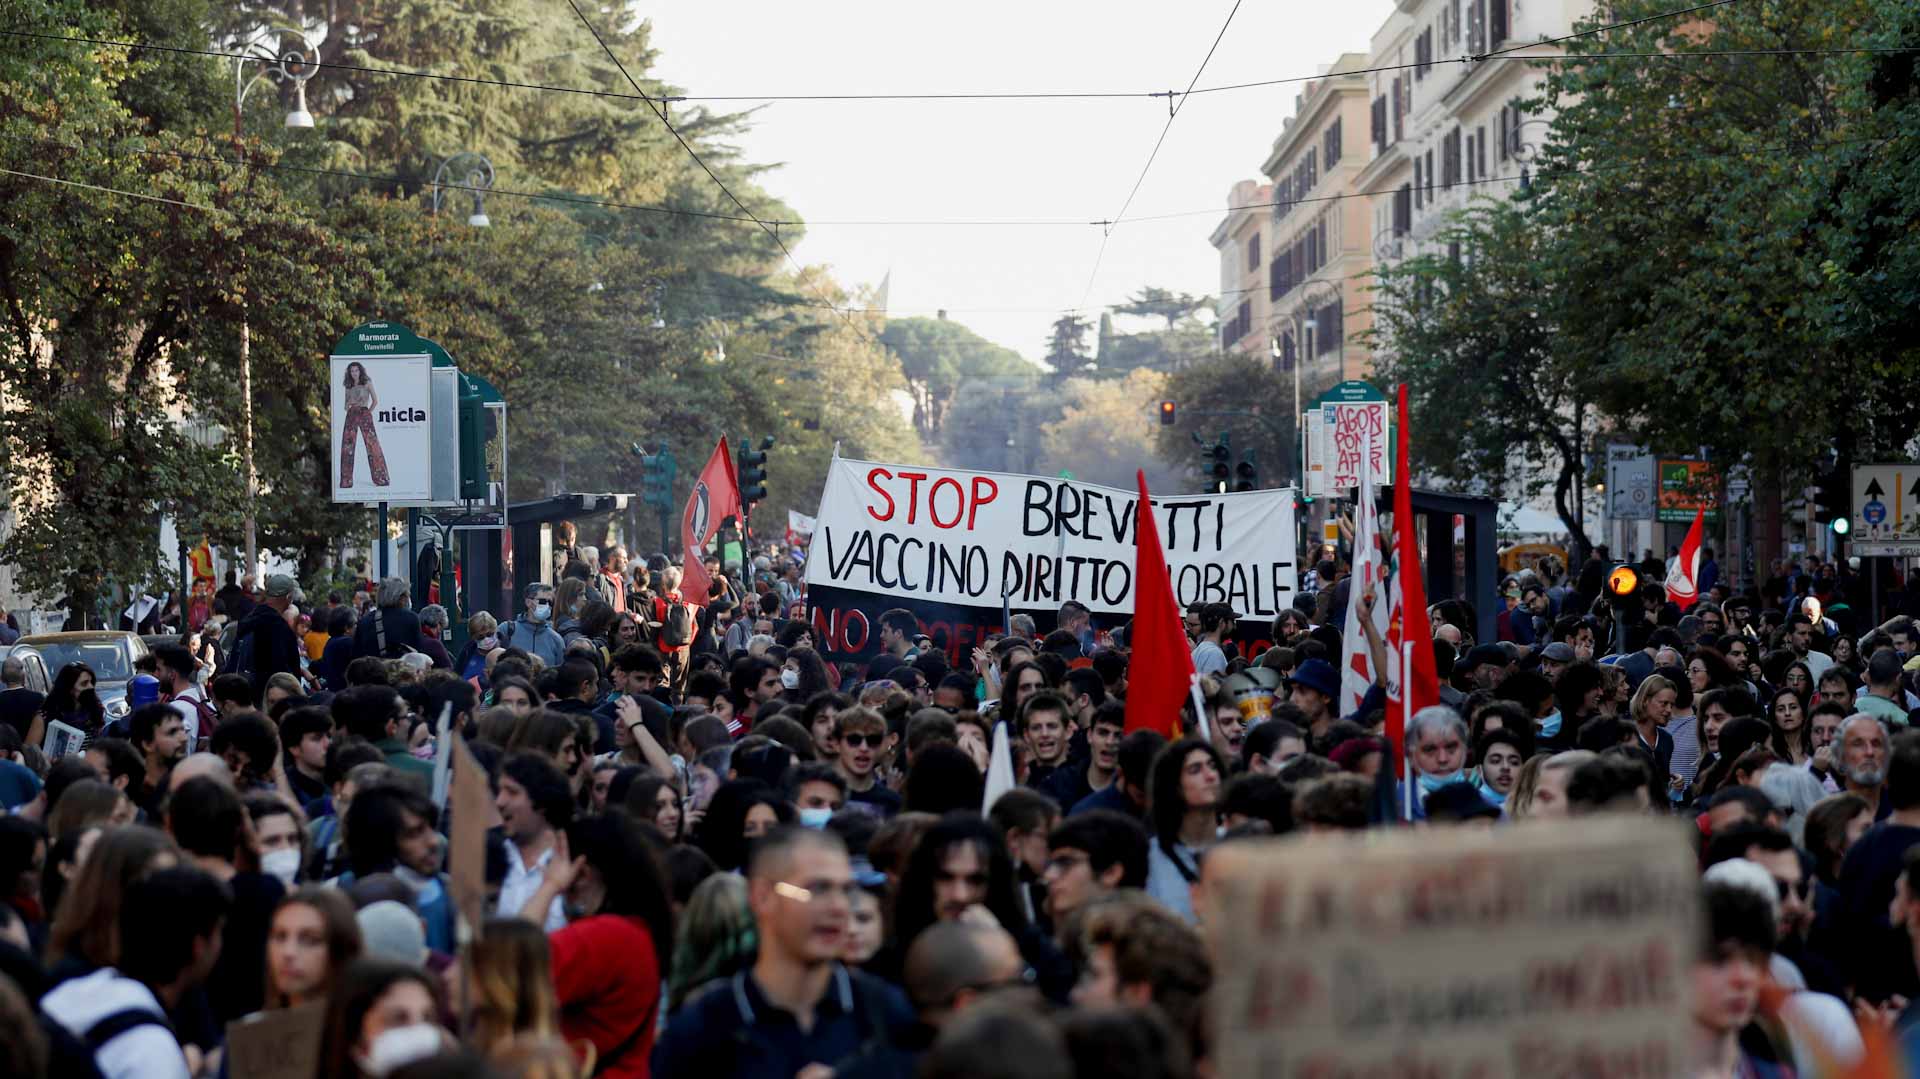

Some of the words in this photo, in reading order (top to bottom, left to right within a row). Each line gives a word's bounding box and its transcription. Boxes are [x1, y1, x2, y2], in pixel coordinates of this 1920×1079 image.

[358, 333, 400, 342] Marmorata
[377, 407, 426, 423] nicla
[867, 468, 998, 530] STOP
[825, 526, 989, 597] VACCINO
[1001, 550, 1131, 606] DIRITTO
[1167, 561, 1292, 616] OBALE
[811, 606, 870, 654] NO
